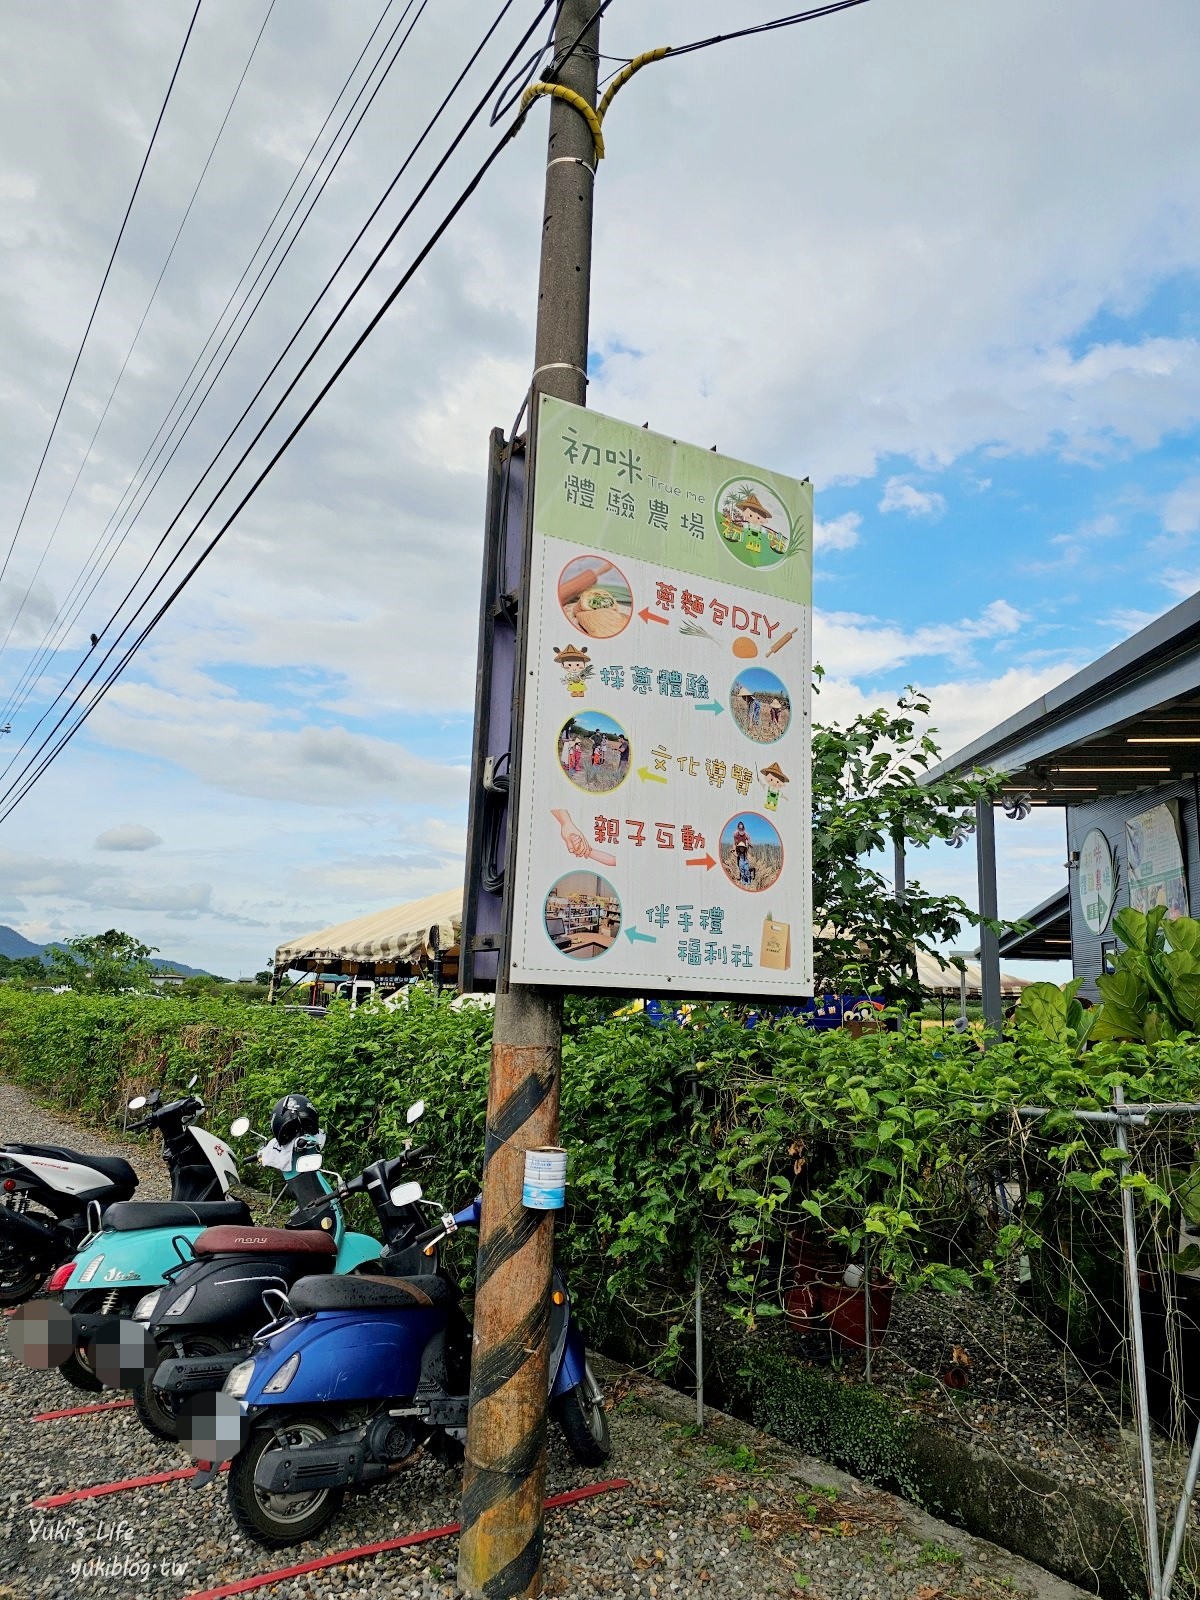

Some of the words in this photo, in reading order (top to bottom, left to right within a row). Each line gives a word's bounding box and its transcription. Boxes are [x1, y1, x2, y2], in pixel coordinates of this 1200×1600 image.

[561, 426, 643, 484] 初咪
[564, 474, 705, 540] 體驗農場
[648, 474, 682, 497] True
[686, 490, 706, 504] me
[651, 744, 754, 796] 文化導覽
[594, 814, 706, 851] 親子互動
[645, 903, 725, 935] 伴手禮
[677, 937, 754, 968] 福利社
